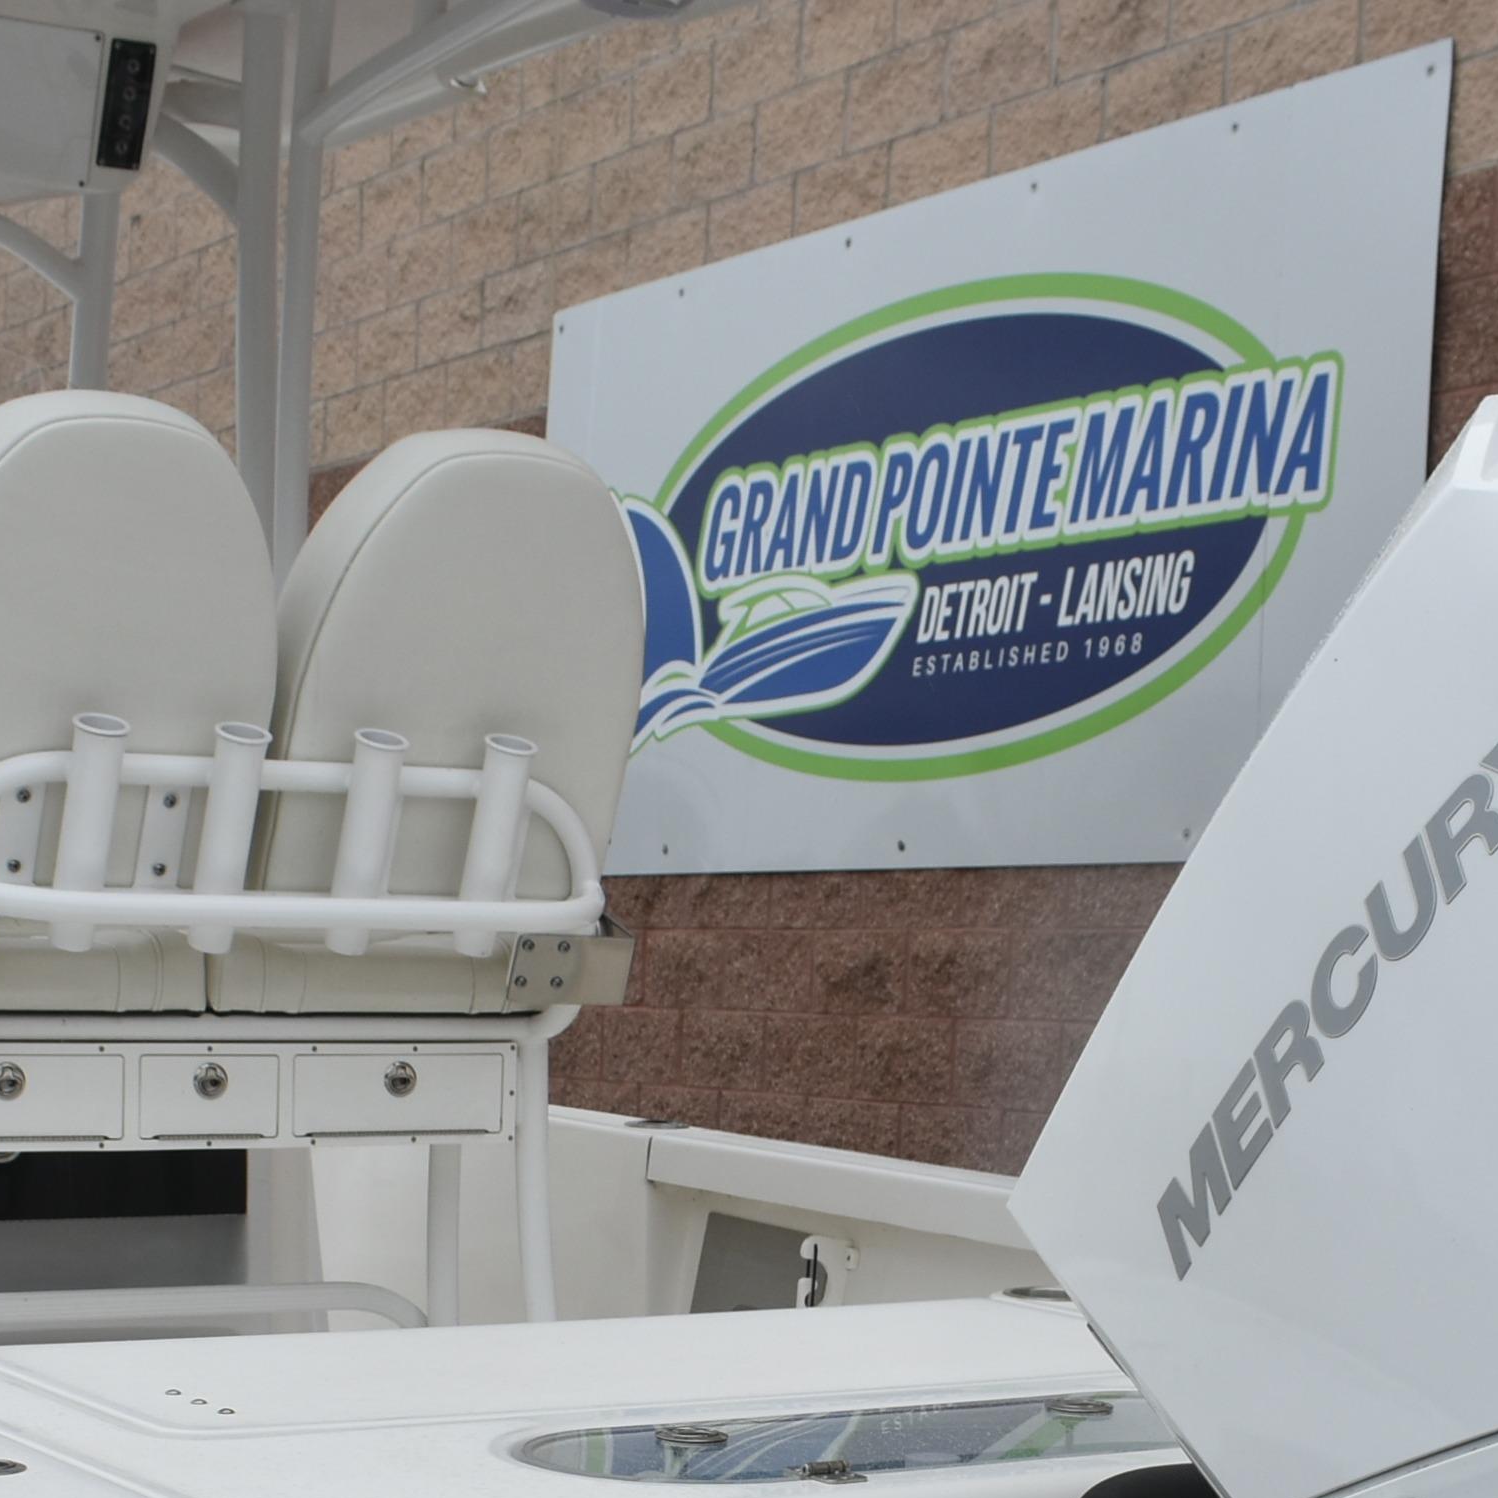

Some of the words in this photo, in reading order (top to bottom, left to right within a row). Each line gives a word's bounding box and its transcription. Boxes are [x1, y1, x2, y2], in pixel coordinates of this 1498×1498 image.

[704, 460, 872, 583] GRAND
[871, 418, 1077, 555] POINTE
[1068, 372, 1330, 524] MARINA
[916, 571, 1038, 644] DETROIT
[1057, 549, 1195, 627] LANSING
[912, 641, 1069, 677] ESTABLISHED
[1085, 632, 1144, 660] 1968
